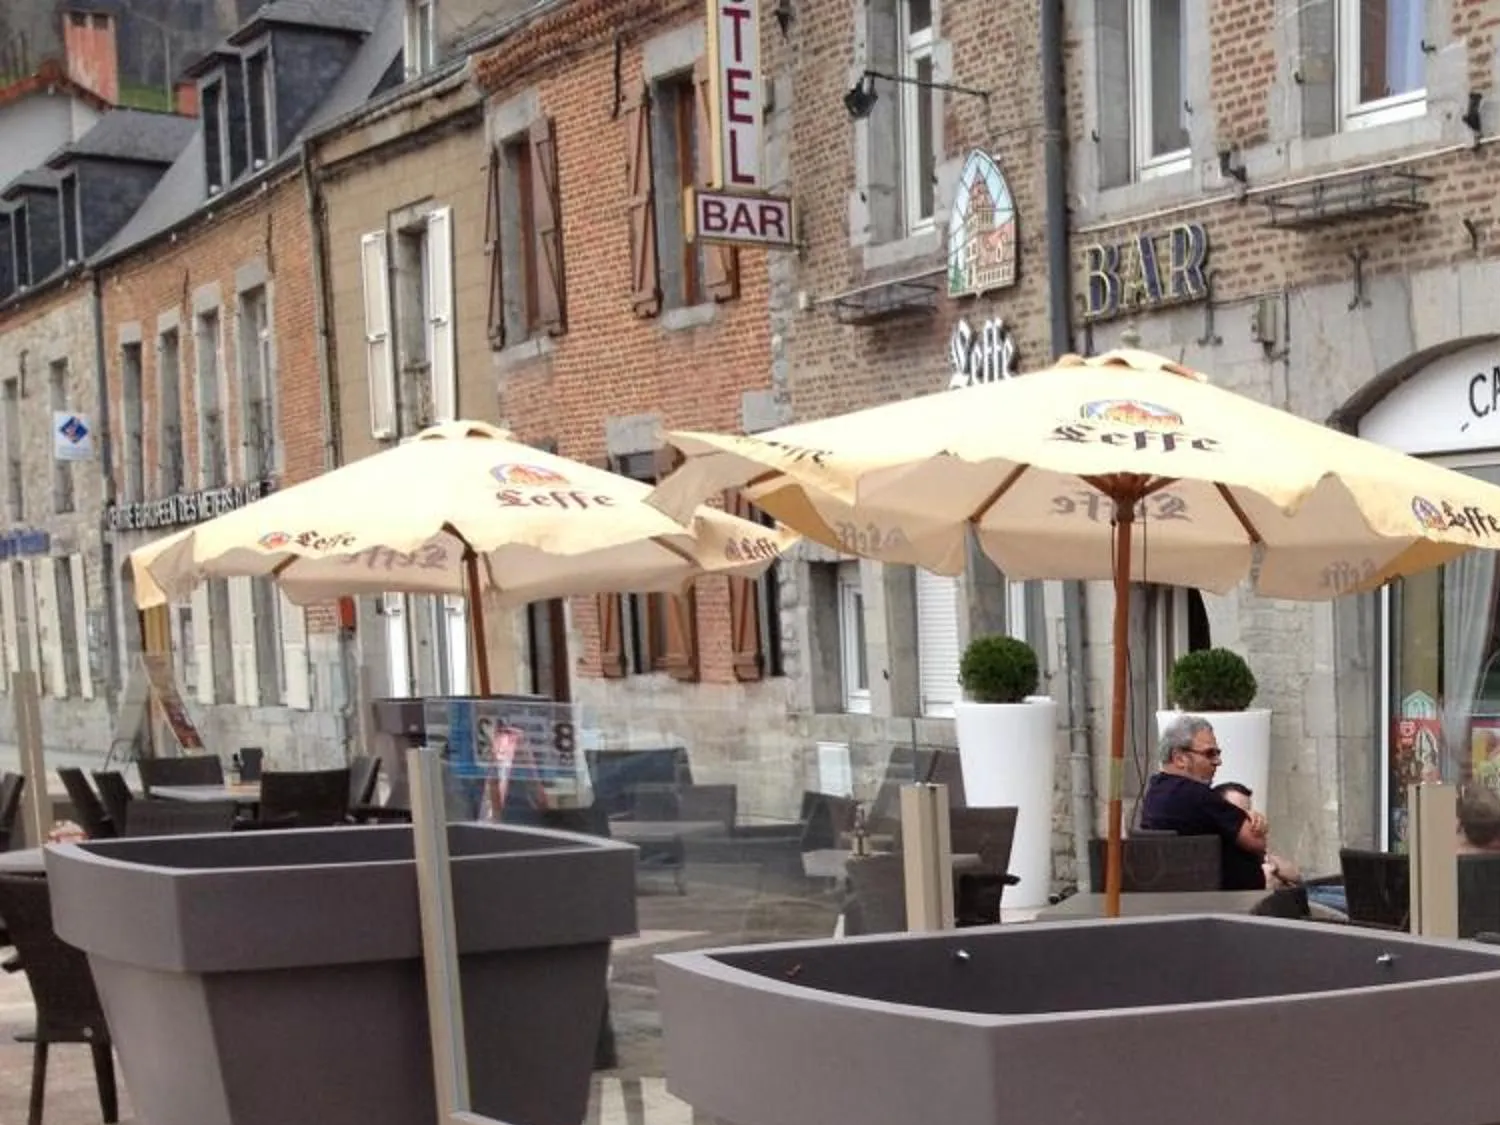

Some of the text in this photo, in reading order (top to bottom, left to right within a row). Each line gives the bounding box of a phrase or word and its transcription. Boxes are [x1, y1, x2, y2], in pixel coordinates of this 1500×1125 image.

[722, 0, 756, 185] TEL
[702, 200, 785, 238] BAR
[1083, 221, 1210, 320] BAR
[950, 316, 1016, 388] Leffe
[1047, 420, 1224, 452] Leffe
[495, 488, 616, 510] Leffe
[294, 529, 357, 550] Leffe
